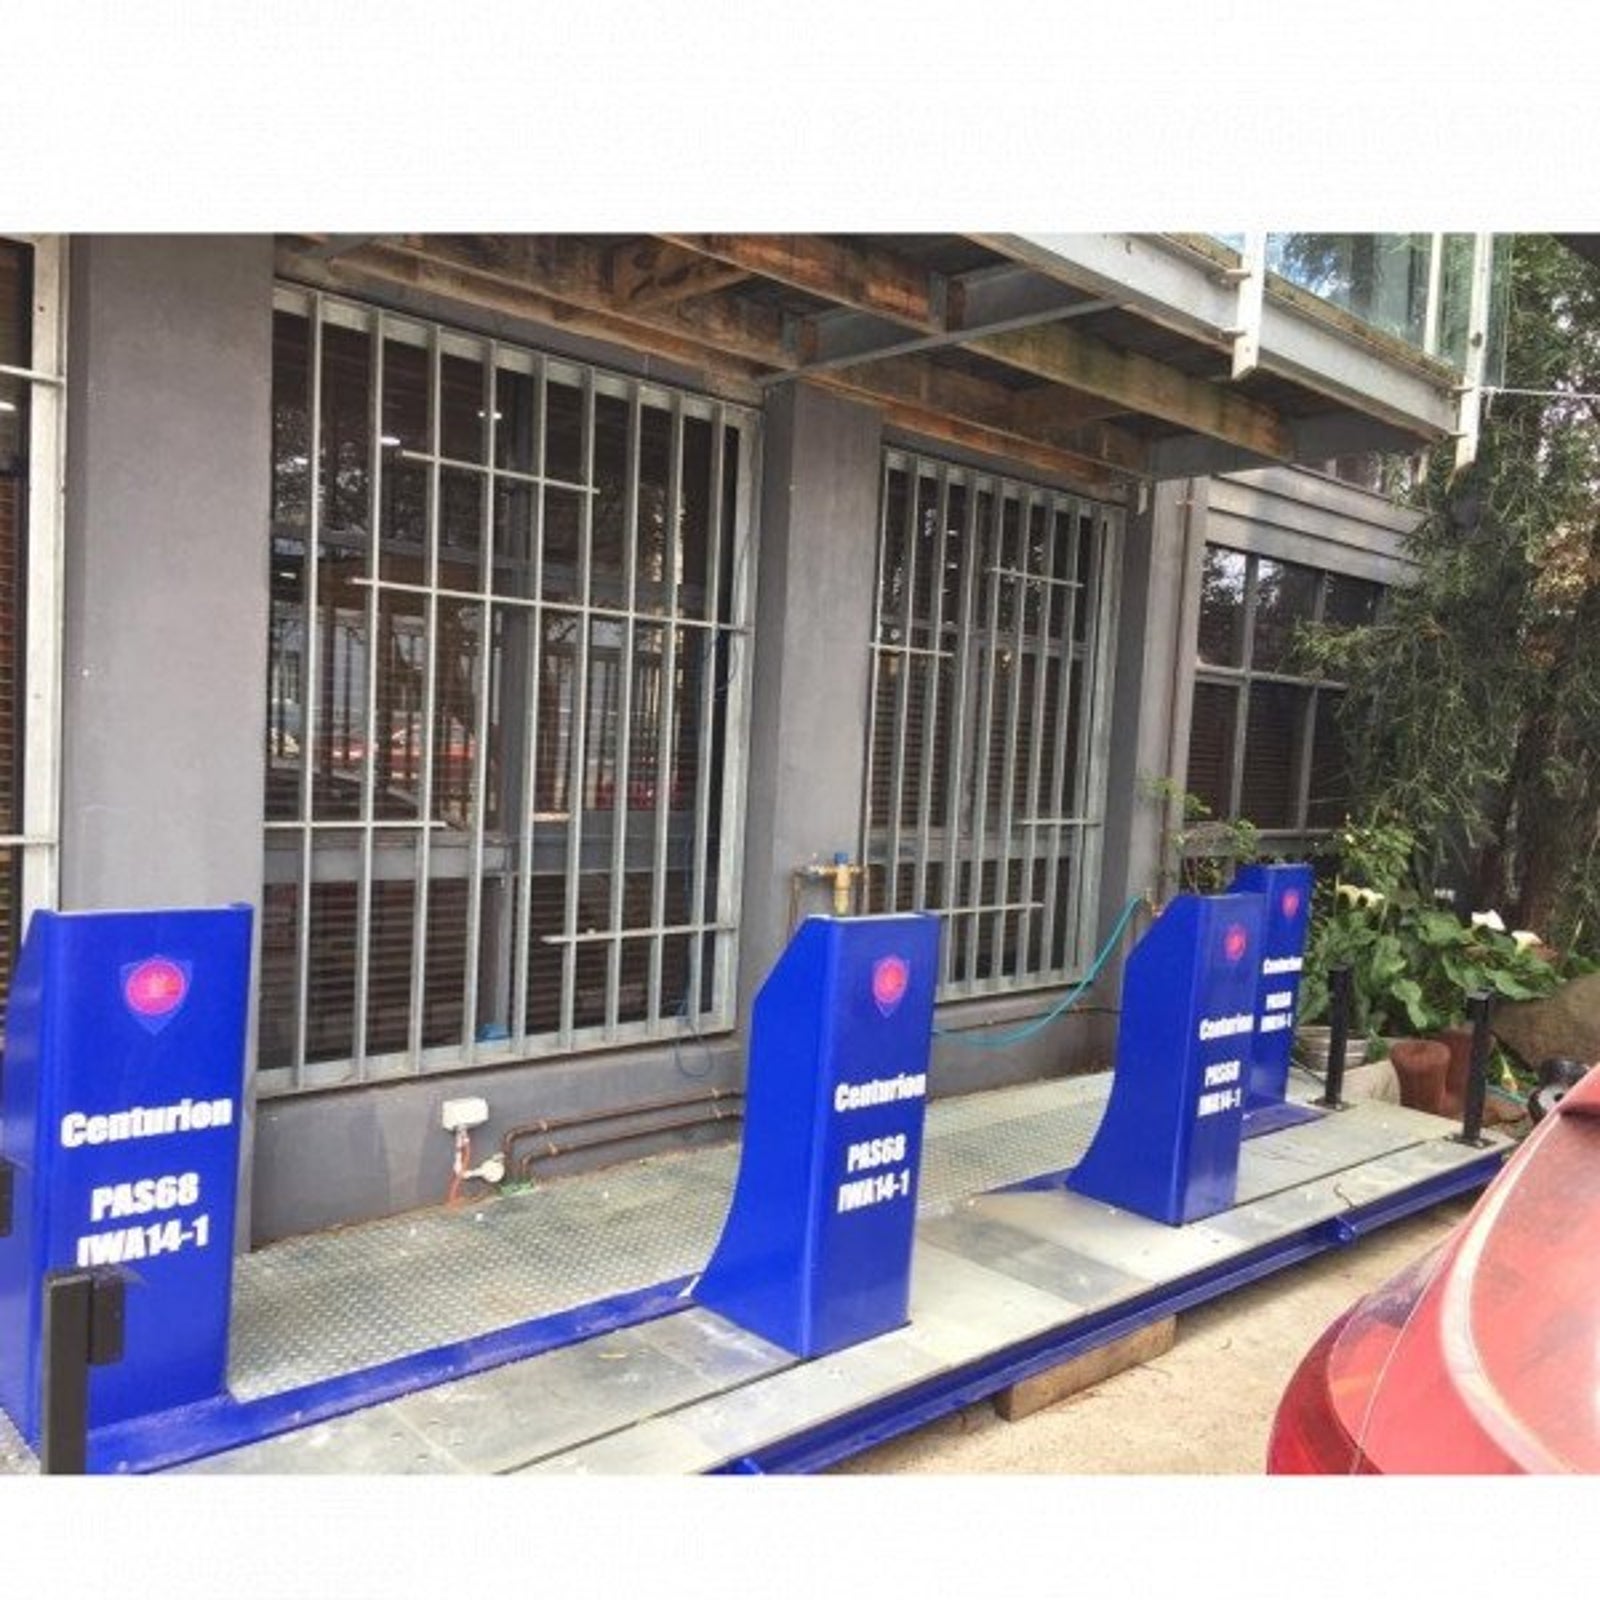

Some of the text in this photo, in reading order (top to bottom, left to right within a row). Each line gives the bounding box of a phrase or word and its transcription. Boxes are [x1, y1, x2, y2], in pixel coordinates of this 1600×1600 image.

[834, 1072, 926, 1113] Centurion
[60, 1098, 233, 1148] Centurion
[847, 1133, 907, 1173] PAS68
[90, 1172, 199, 1222] PAS68
[76, 1213, 209, 1268] IWA14-1
